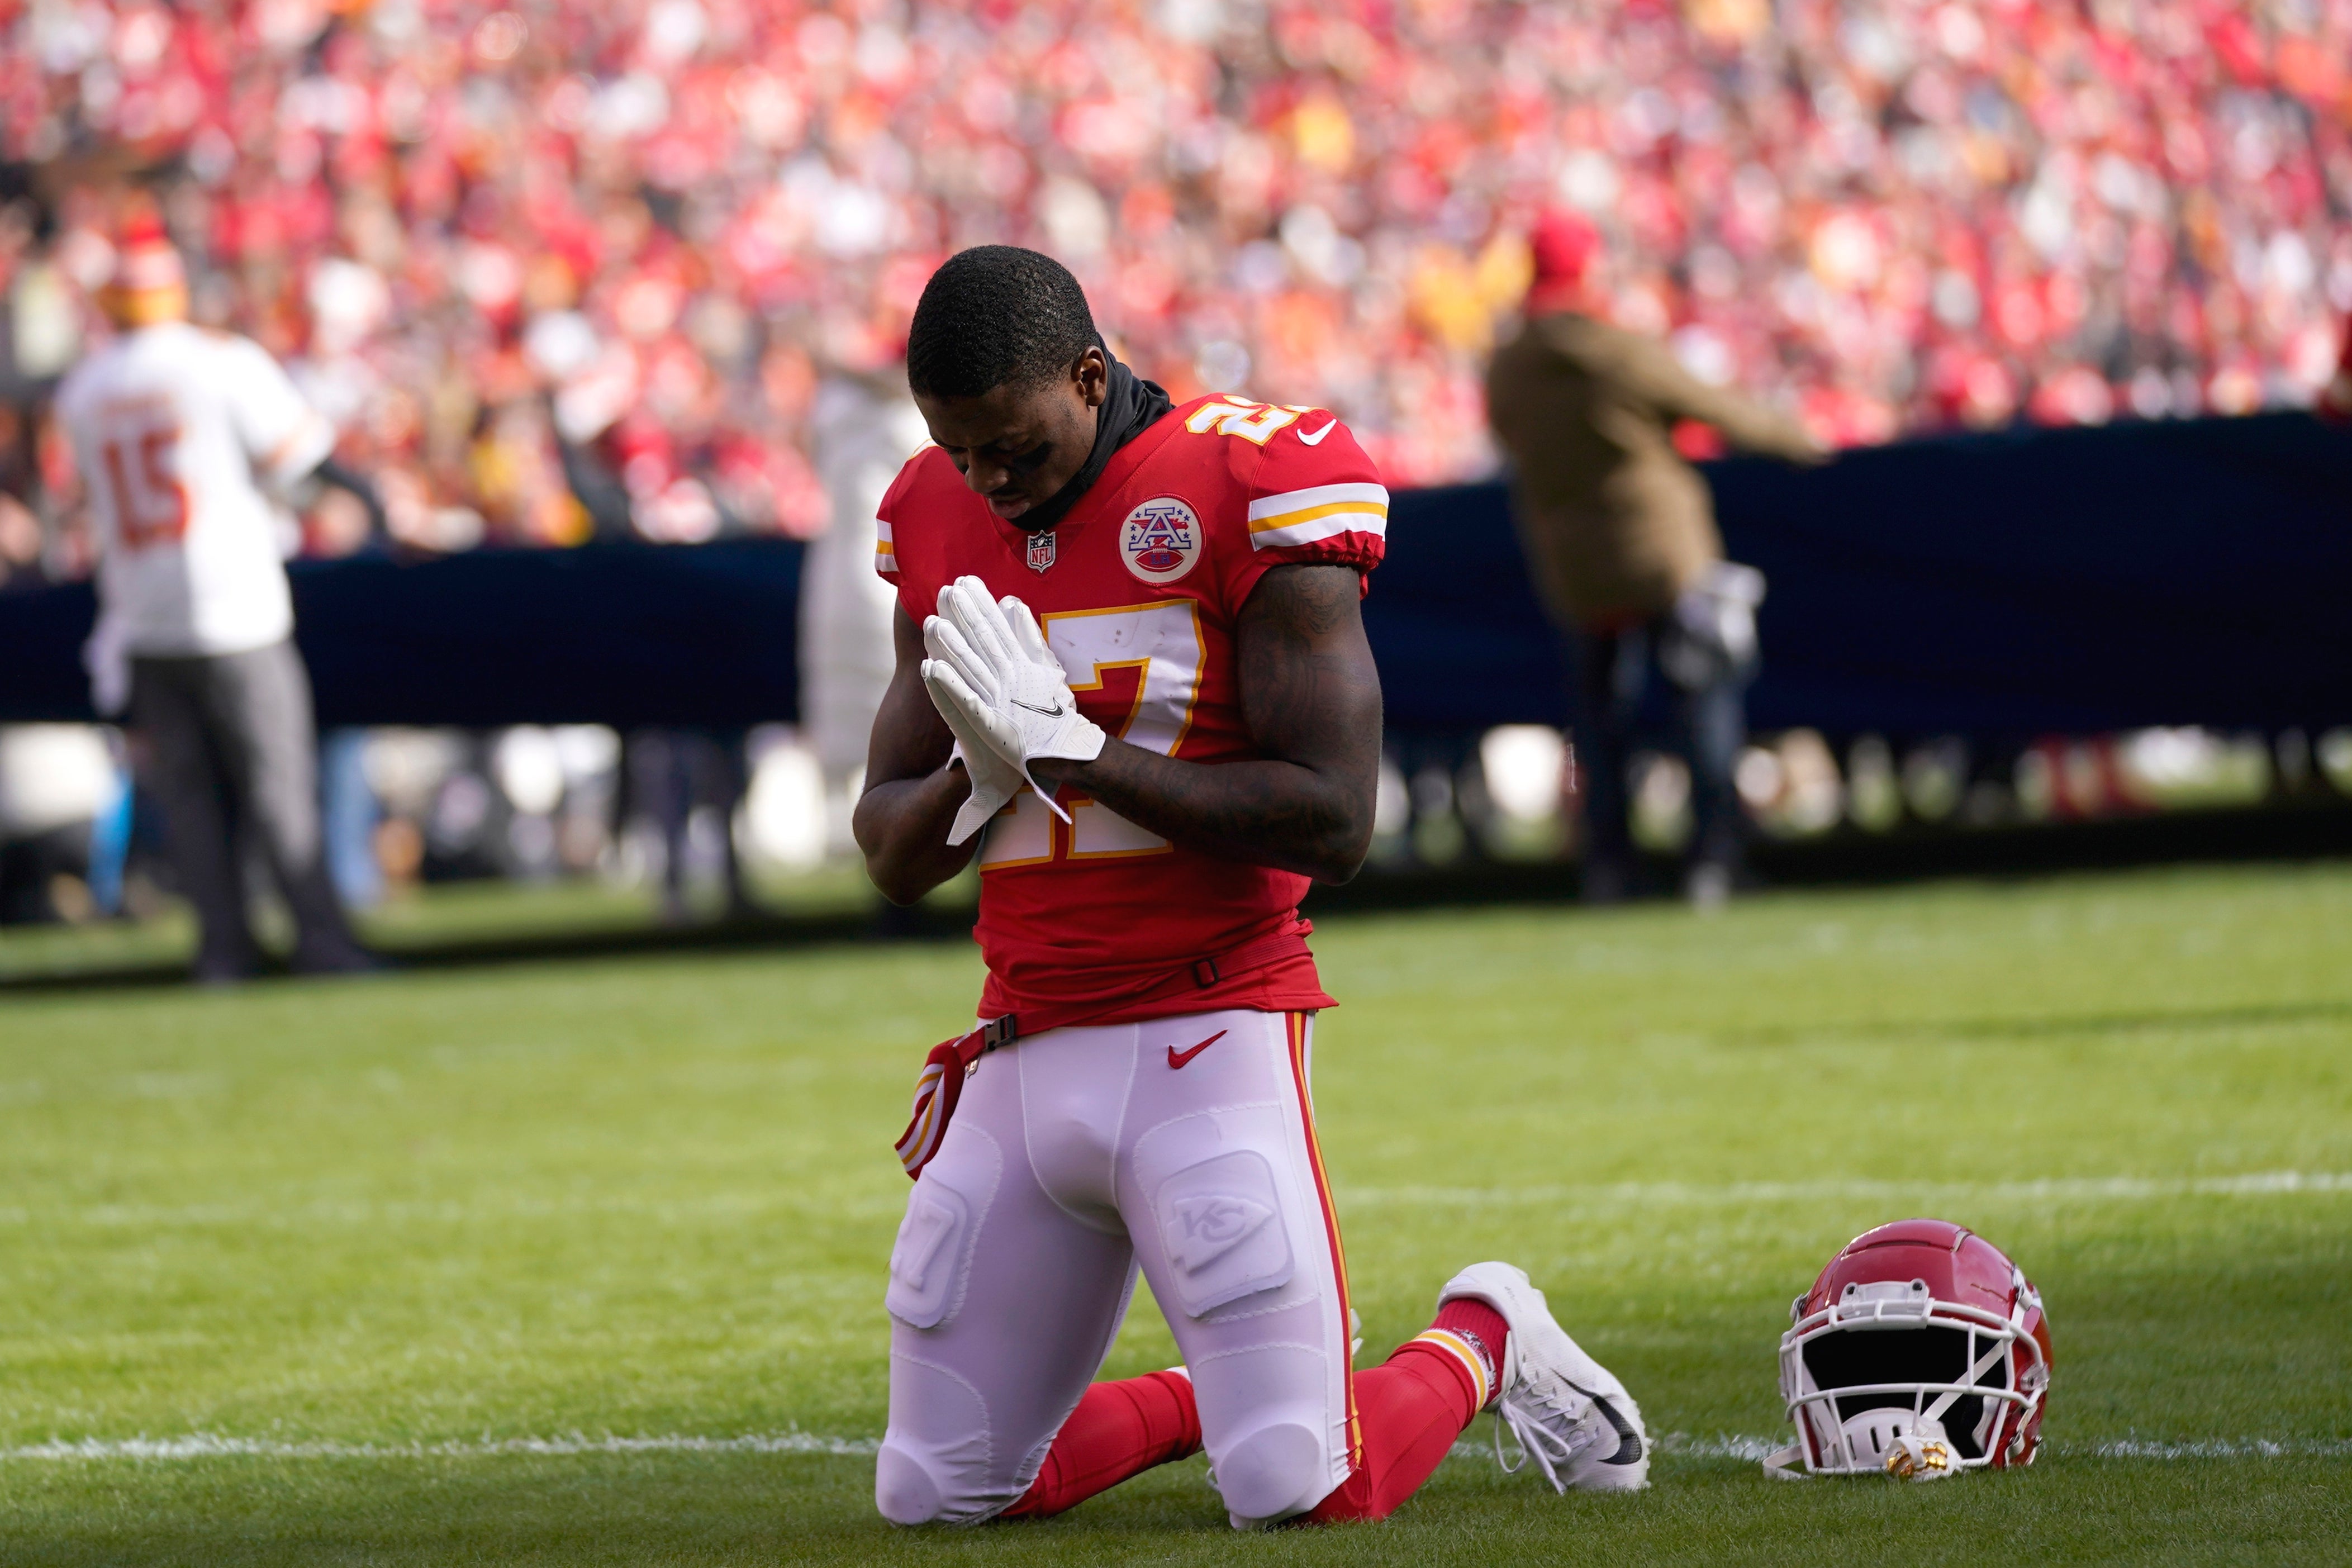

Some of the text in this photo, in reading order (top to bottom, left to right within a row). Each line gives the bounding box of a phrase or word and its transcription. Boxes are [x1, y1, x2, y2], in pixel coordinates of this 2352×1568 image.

[1185, 393, 1329, 446] 2
[102, 429, 189, 550] 15
[1031, 547, 1052, 565] NFL
[1150, 553, 1171, 565] LH
[1181, 1201, 1247, 1243] KC
